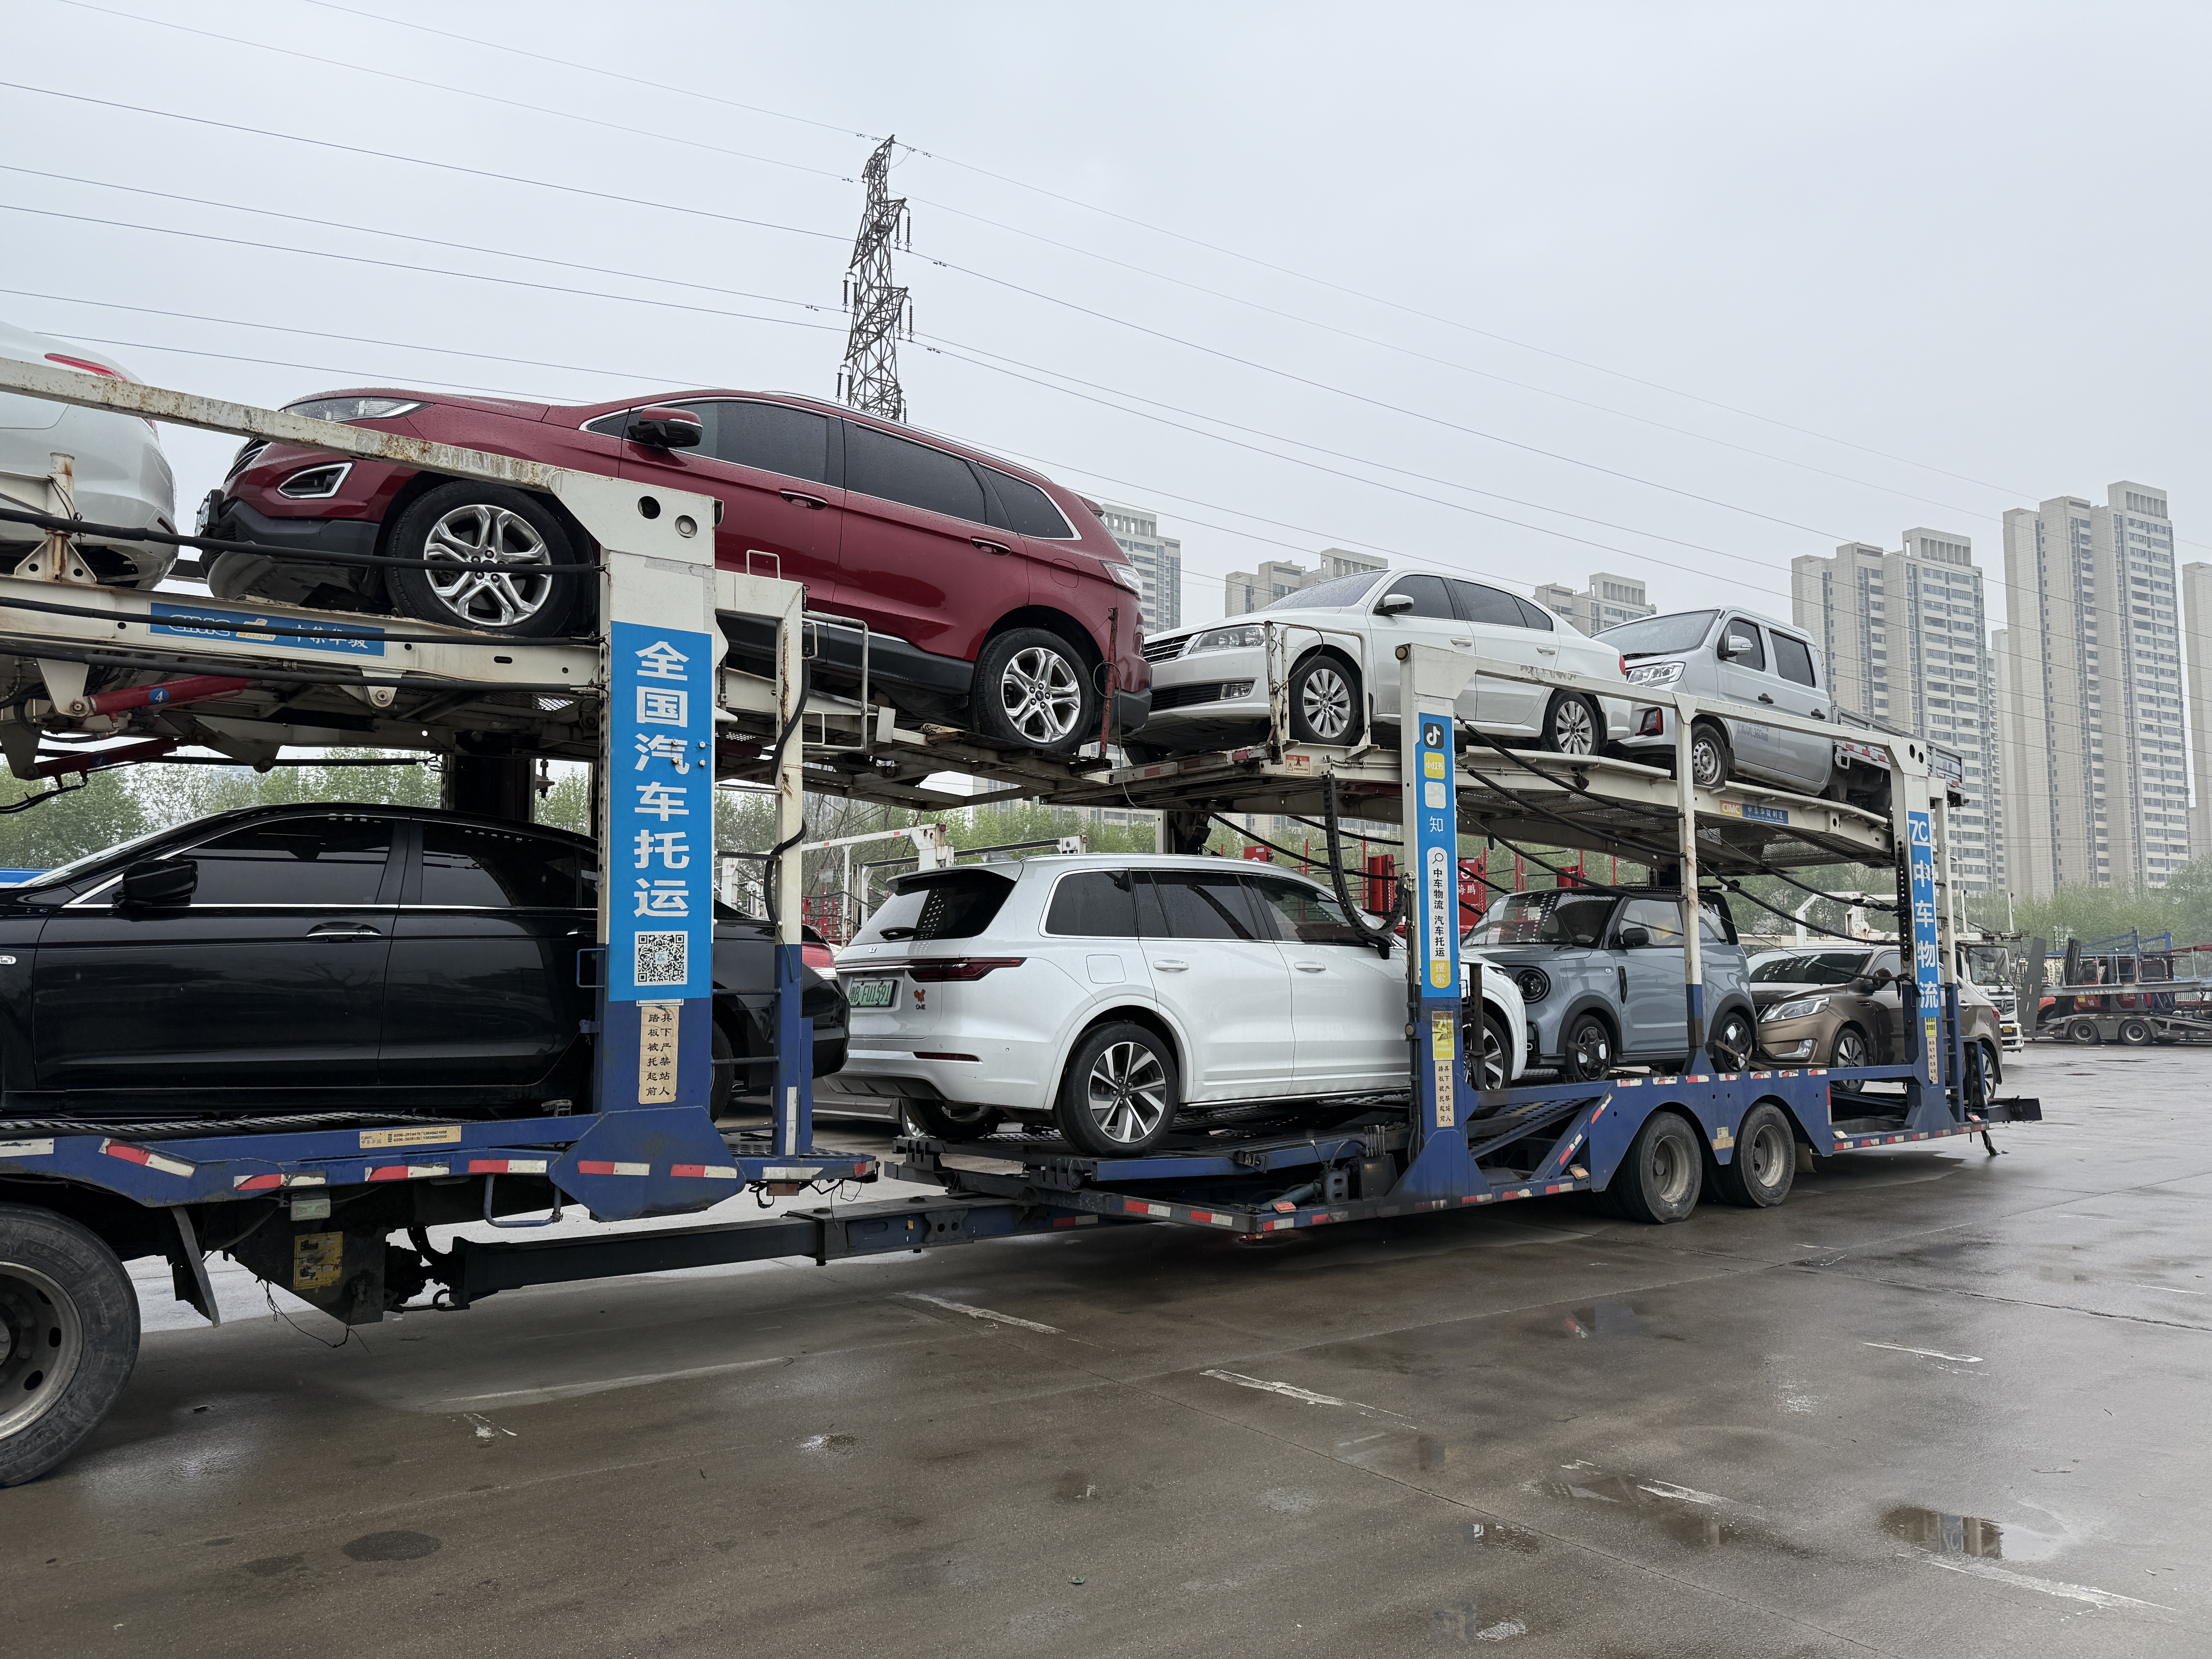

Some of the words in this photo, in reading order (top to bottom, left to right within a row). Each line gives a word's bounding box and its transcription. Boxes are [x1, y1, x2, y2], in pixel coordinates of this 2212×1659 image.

[155, 691, 164, 702] 4
[634, 641, 690, 917] 全国汽车托运
[1426, 761, 1444, 770] 小红书
[1430, 816, 1444, 832] 知
[1722, 803, 1740, 814] CIMC
[1434, 868, 1444, 909] 中车物流
[1434, 915, 1445, 957] 汽车托运
[1913, 860, 1939, 1008] 中车物流
[1435, 963, 1445, 983] 搜索
[646, 1013, 660, 1096] 踏板被托起前
[659, 1013, 672, 1096] 其下严禁站人
